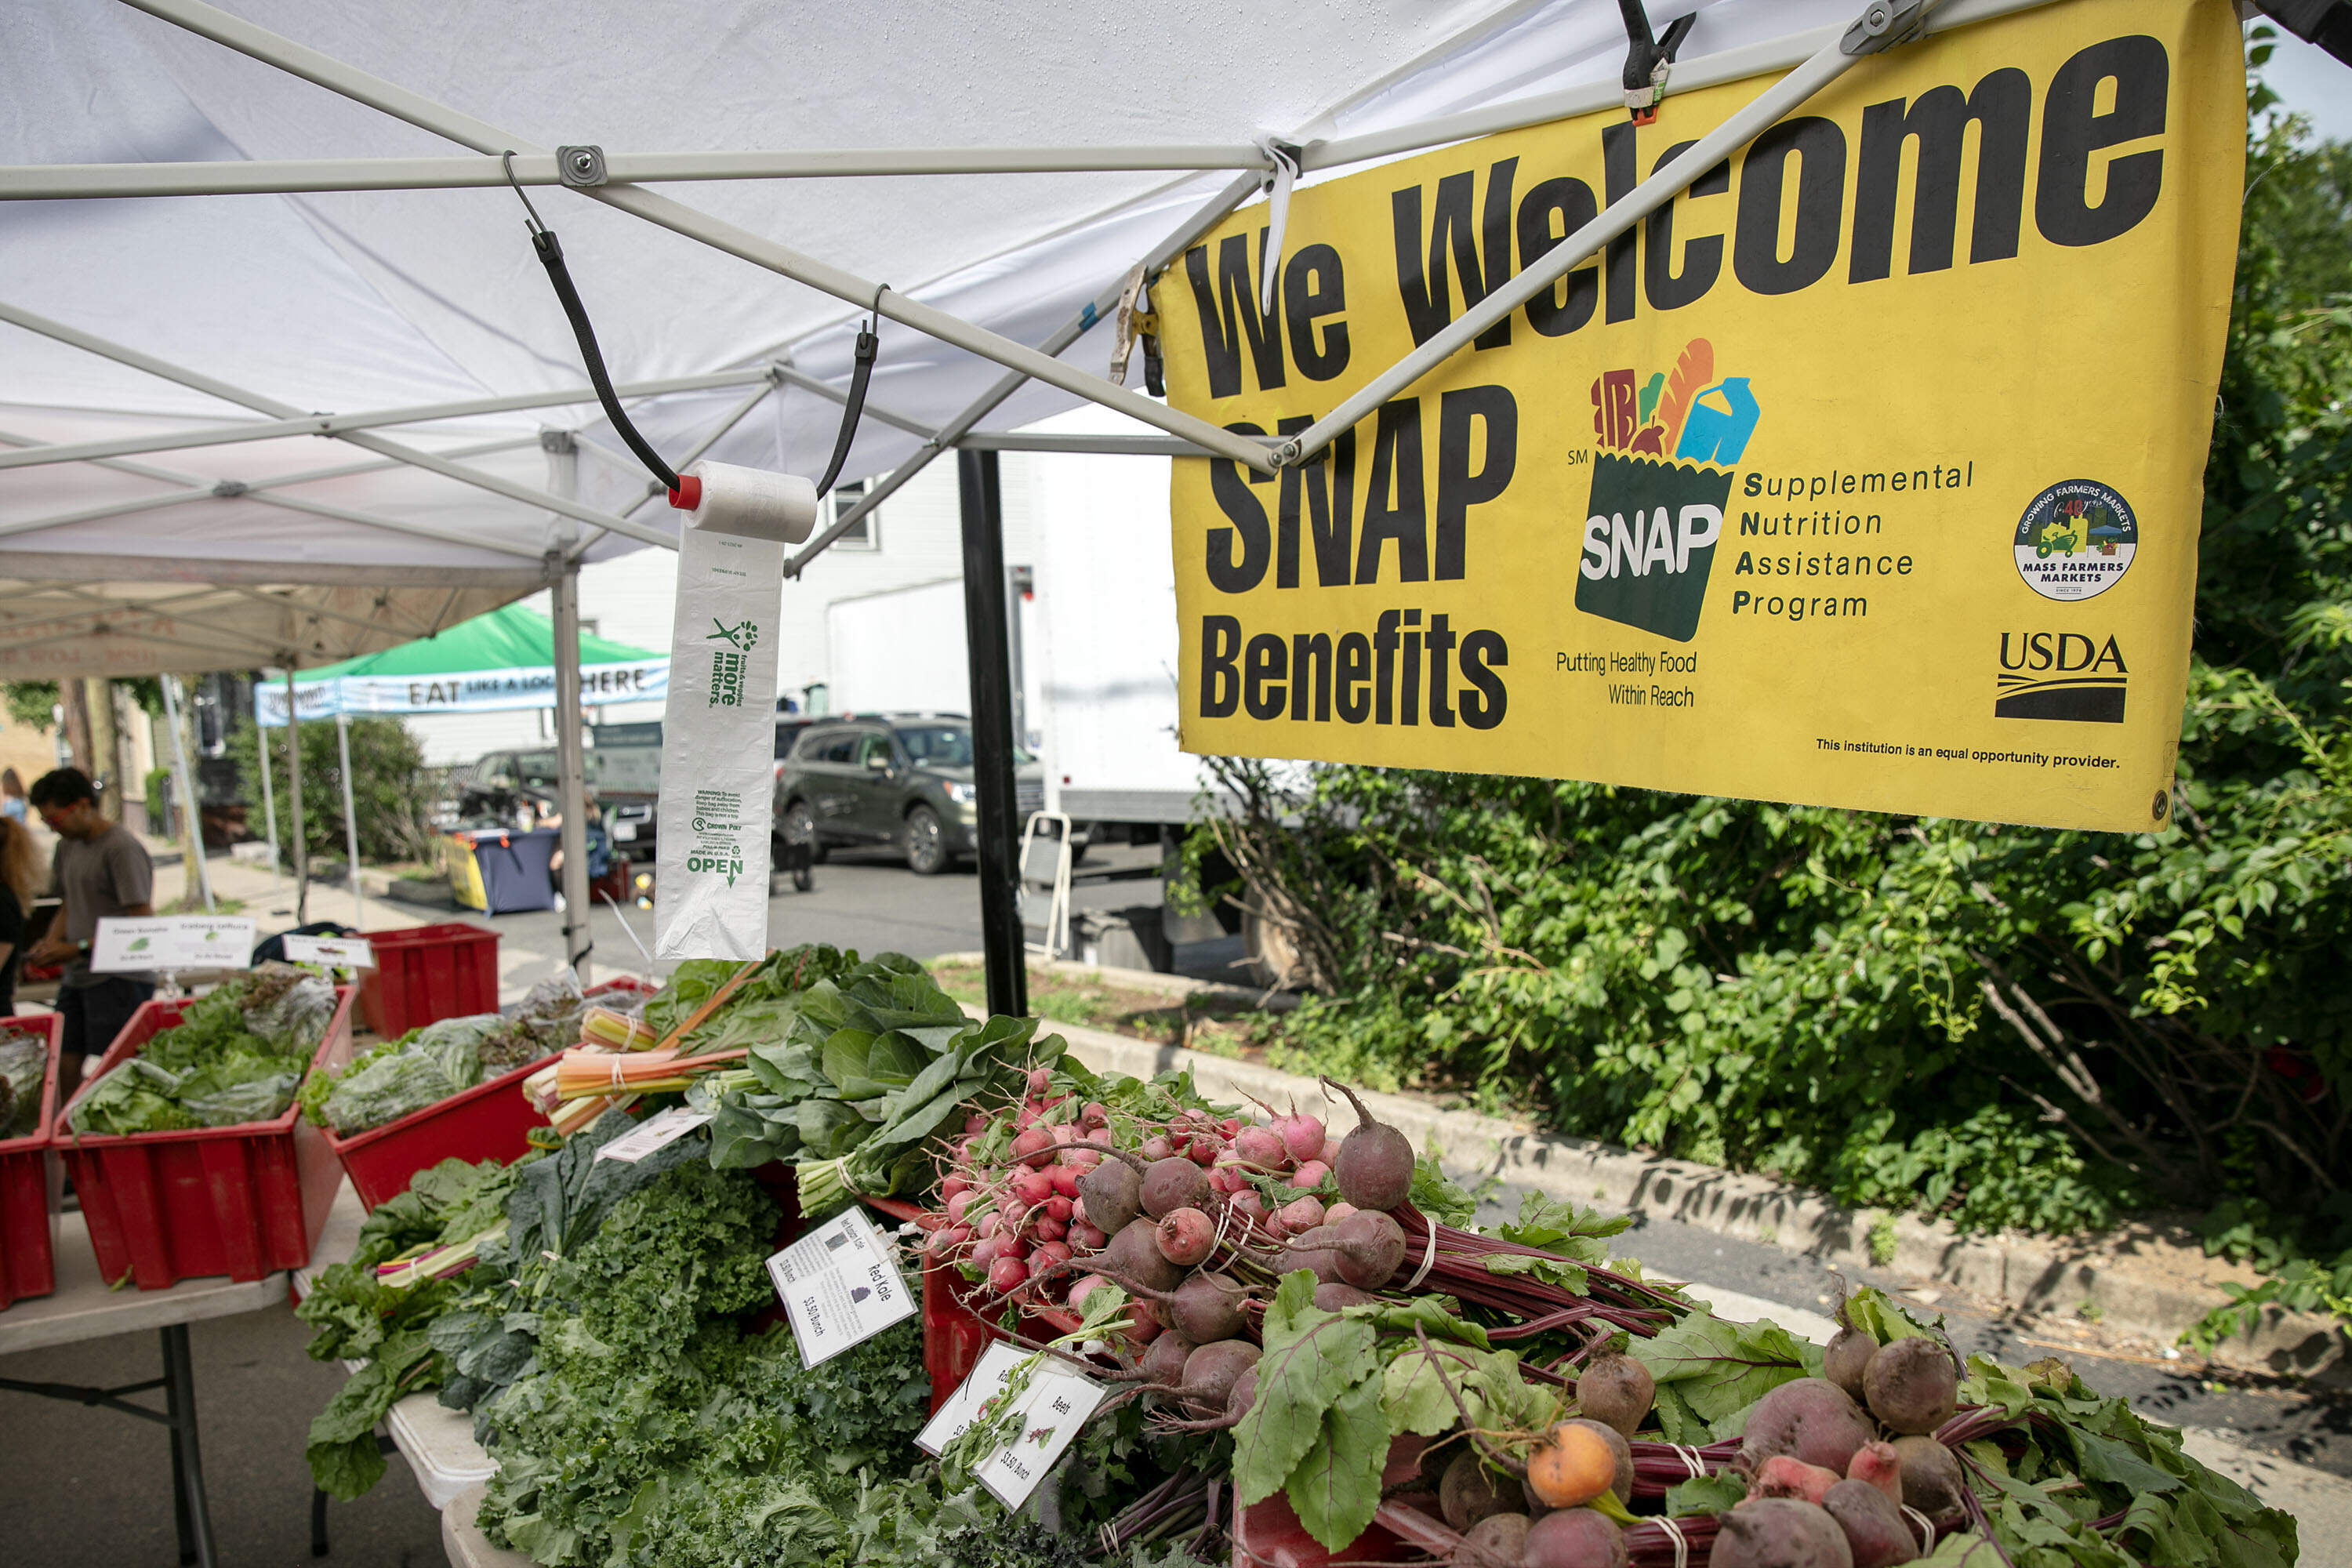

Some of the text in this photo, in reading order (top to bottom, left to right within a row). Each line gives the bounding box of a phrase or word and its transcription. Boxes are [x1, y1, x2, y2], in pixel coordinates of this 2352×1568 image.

[1185, 34, 2169, 398] We Welcome
[1568, 449, 1588, 465] SM
[1206, 385, 1518, 593] SNAP
[1744, 460, 1973, 501] Supplemental
[2021, 485, 2131, 534] GROWING FARMERS MARKETS
[2064, 499, 2082, 516] 40
[1740, 510, 1882, 535] Nutrition
[1581, 503, 1723, 580] SNAP
[1735, 551, 1913, 575] Assistance
[2023, 563, 2124, 572] MASS FARMERS
[1733, 590, 1867, 621] Program
[1556, 652, 1697, 677] Putting Healthy Food
[1998, 632, 2128, 673] USDA
[721, 653, 741, 706] more
[1200, 609, 1508, 730] Benefits
[408, 680, 462, 705] EAT
[466, 679, 499, 692] LIKE
[507, 679, 518, 691] A
[736, 681, 745, 707] veggies
[1609, 684, 1693, 707] Within Reach
[1817, 739, 2120, 768] This institution is an equal opportunity provider.
[687, 857, 743, 874] OPEN
[868, 1264, 892, 1302] Red Kale
[802, 1296, 826, 1338] $3.50/Bunch
[1052, 1396, 1071, 1416] Beets
